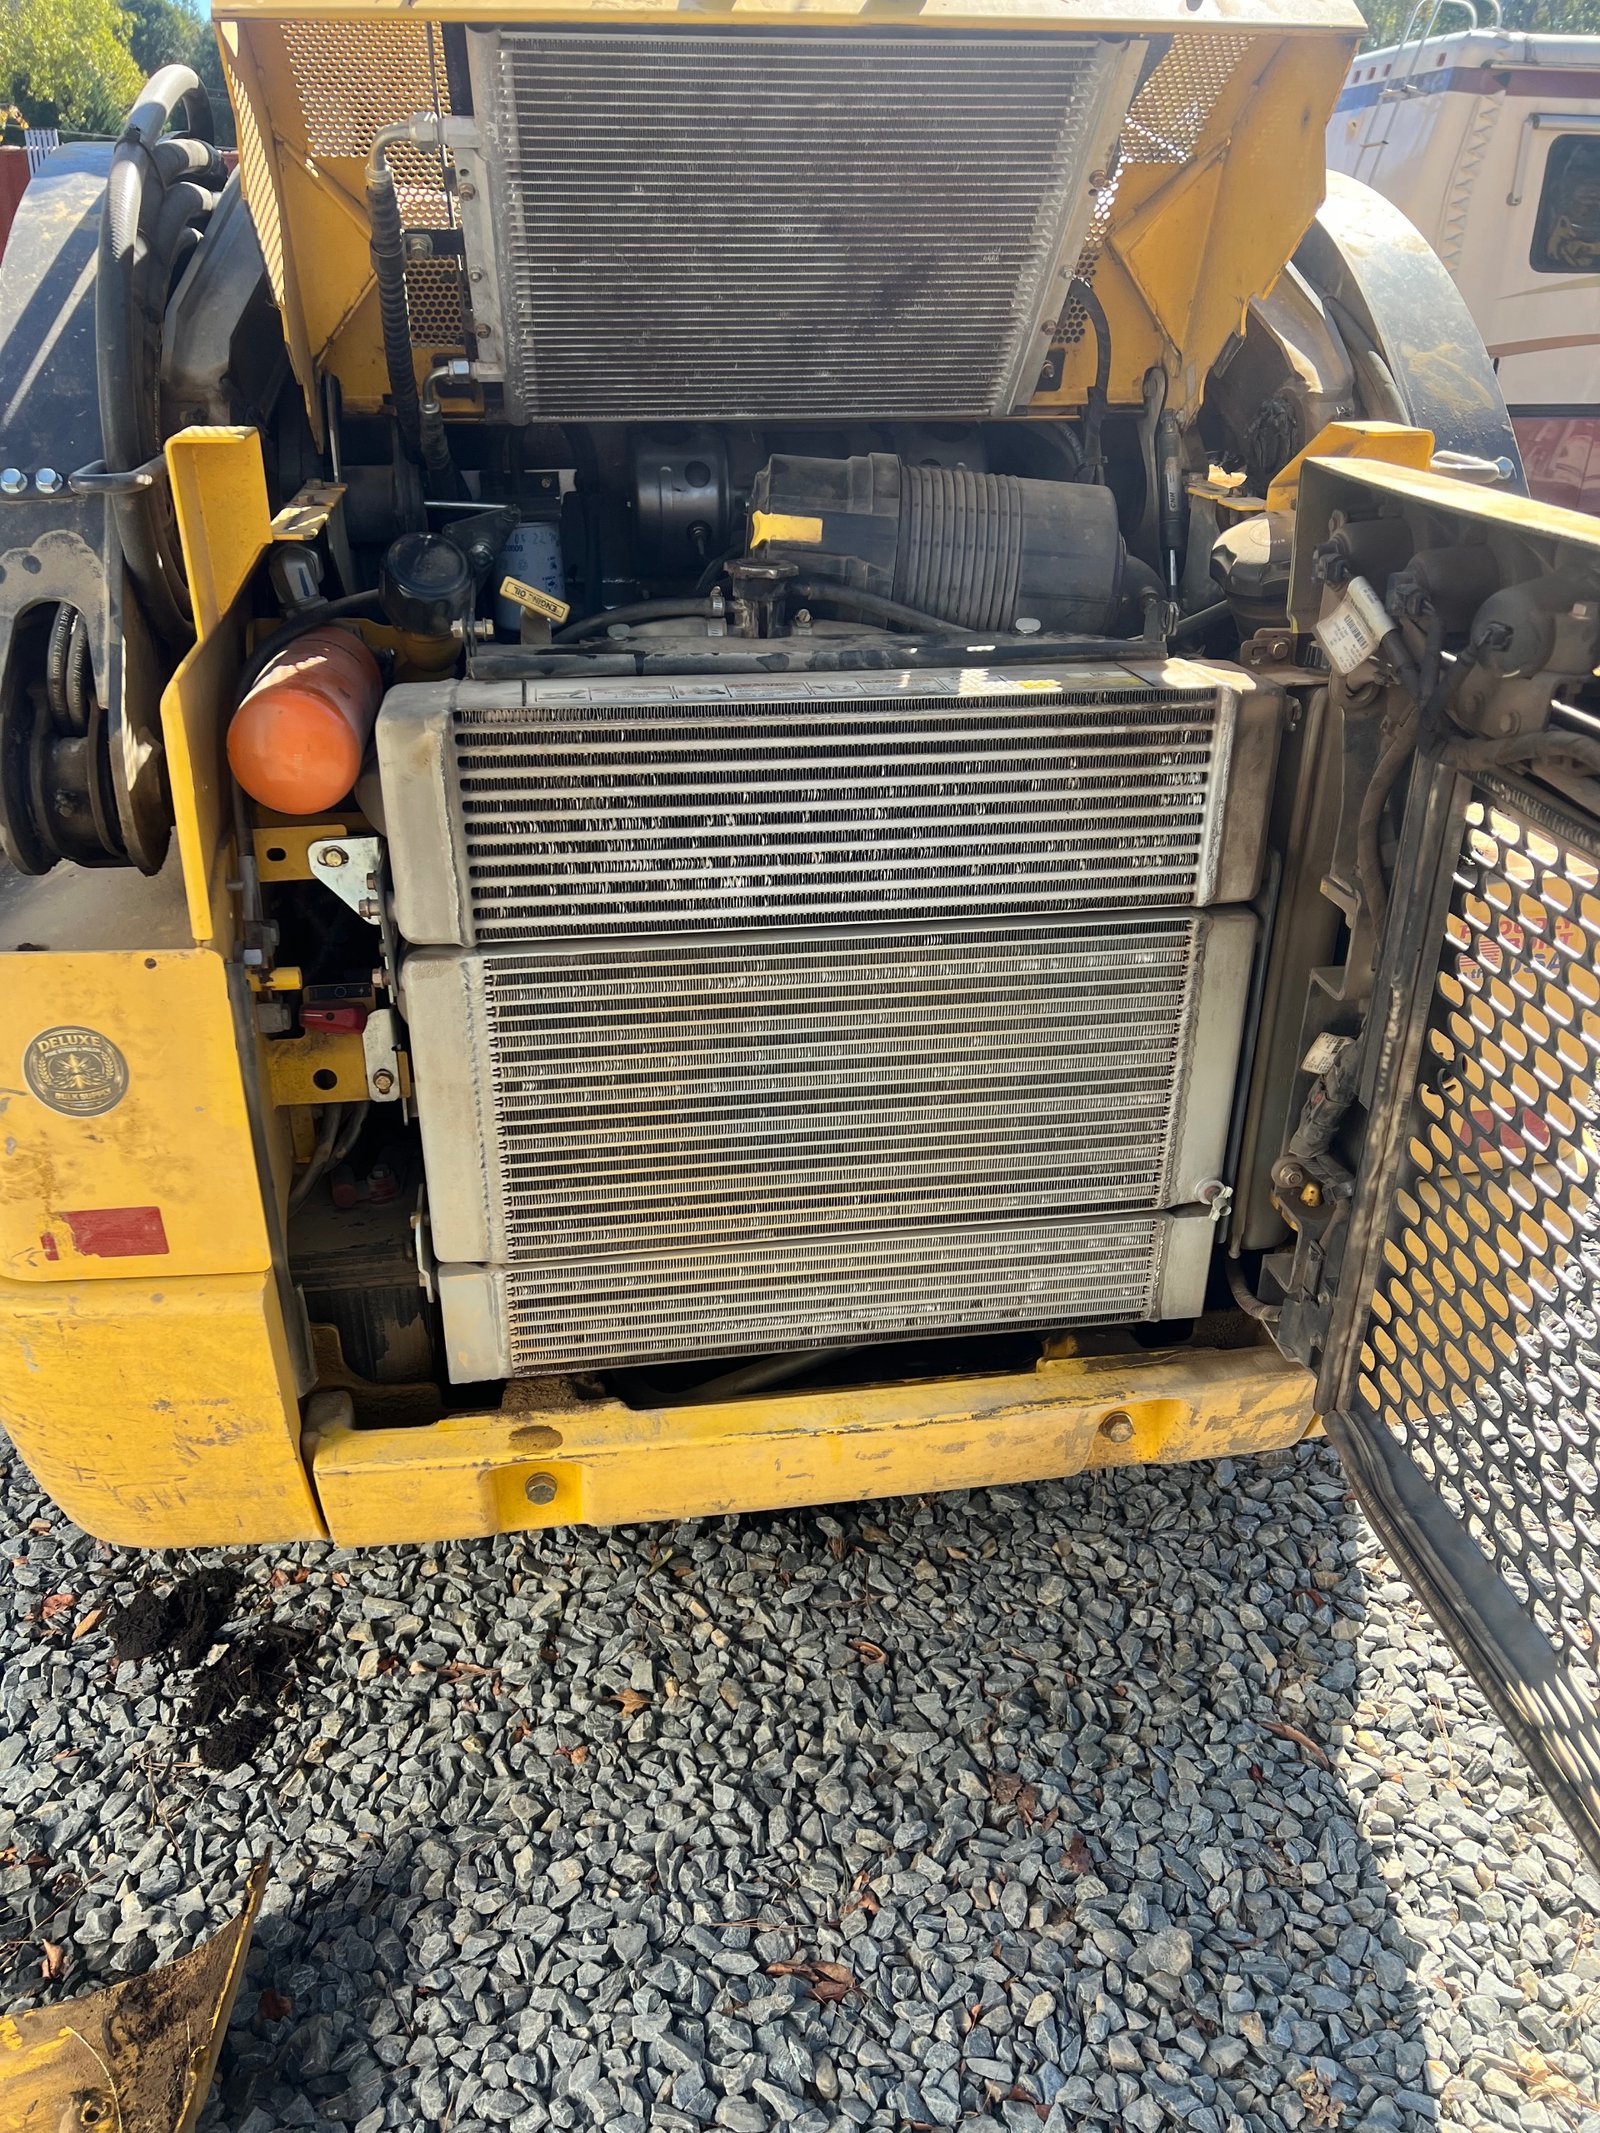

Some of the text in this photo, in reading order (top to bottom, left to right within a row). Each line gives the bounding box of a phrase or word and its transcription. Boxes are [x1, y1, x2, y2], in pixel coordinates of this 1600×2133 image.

[513, 586, 527, 597] OIL
[37, 1035, 101, 1053] DELUXE
[54, 1087, 112, 1101] BULK SUPPLY
